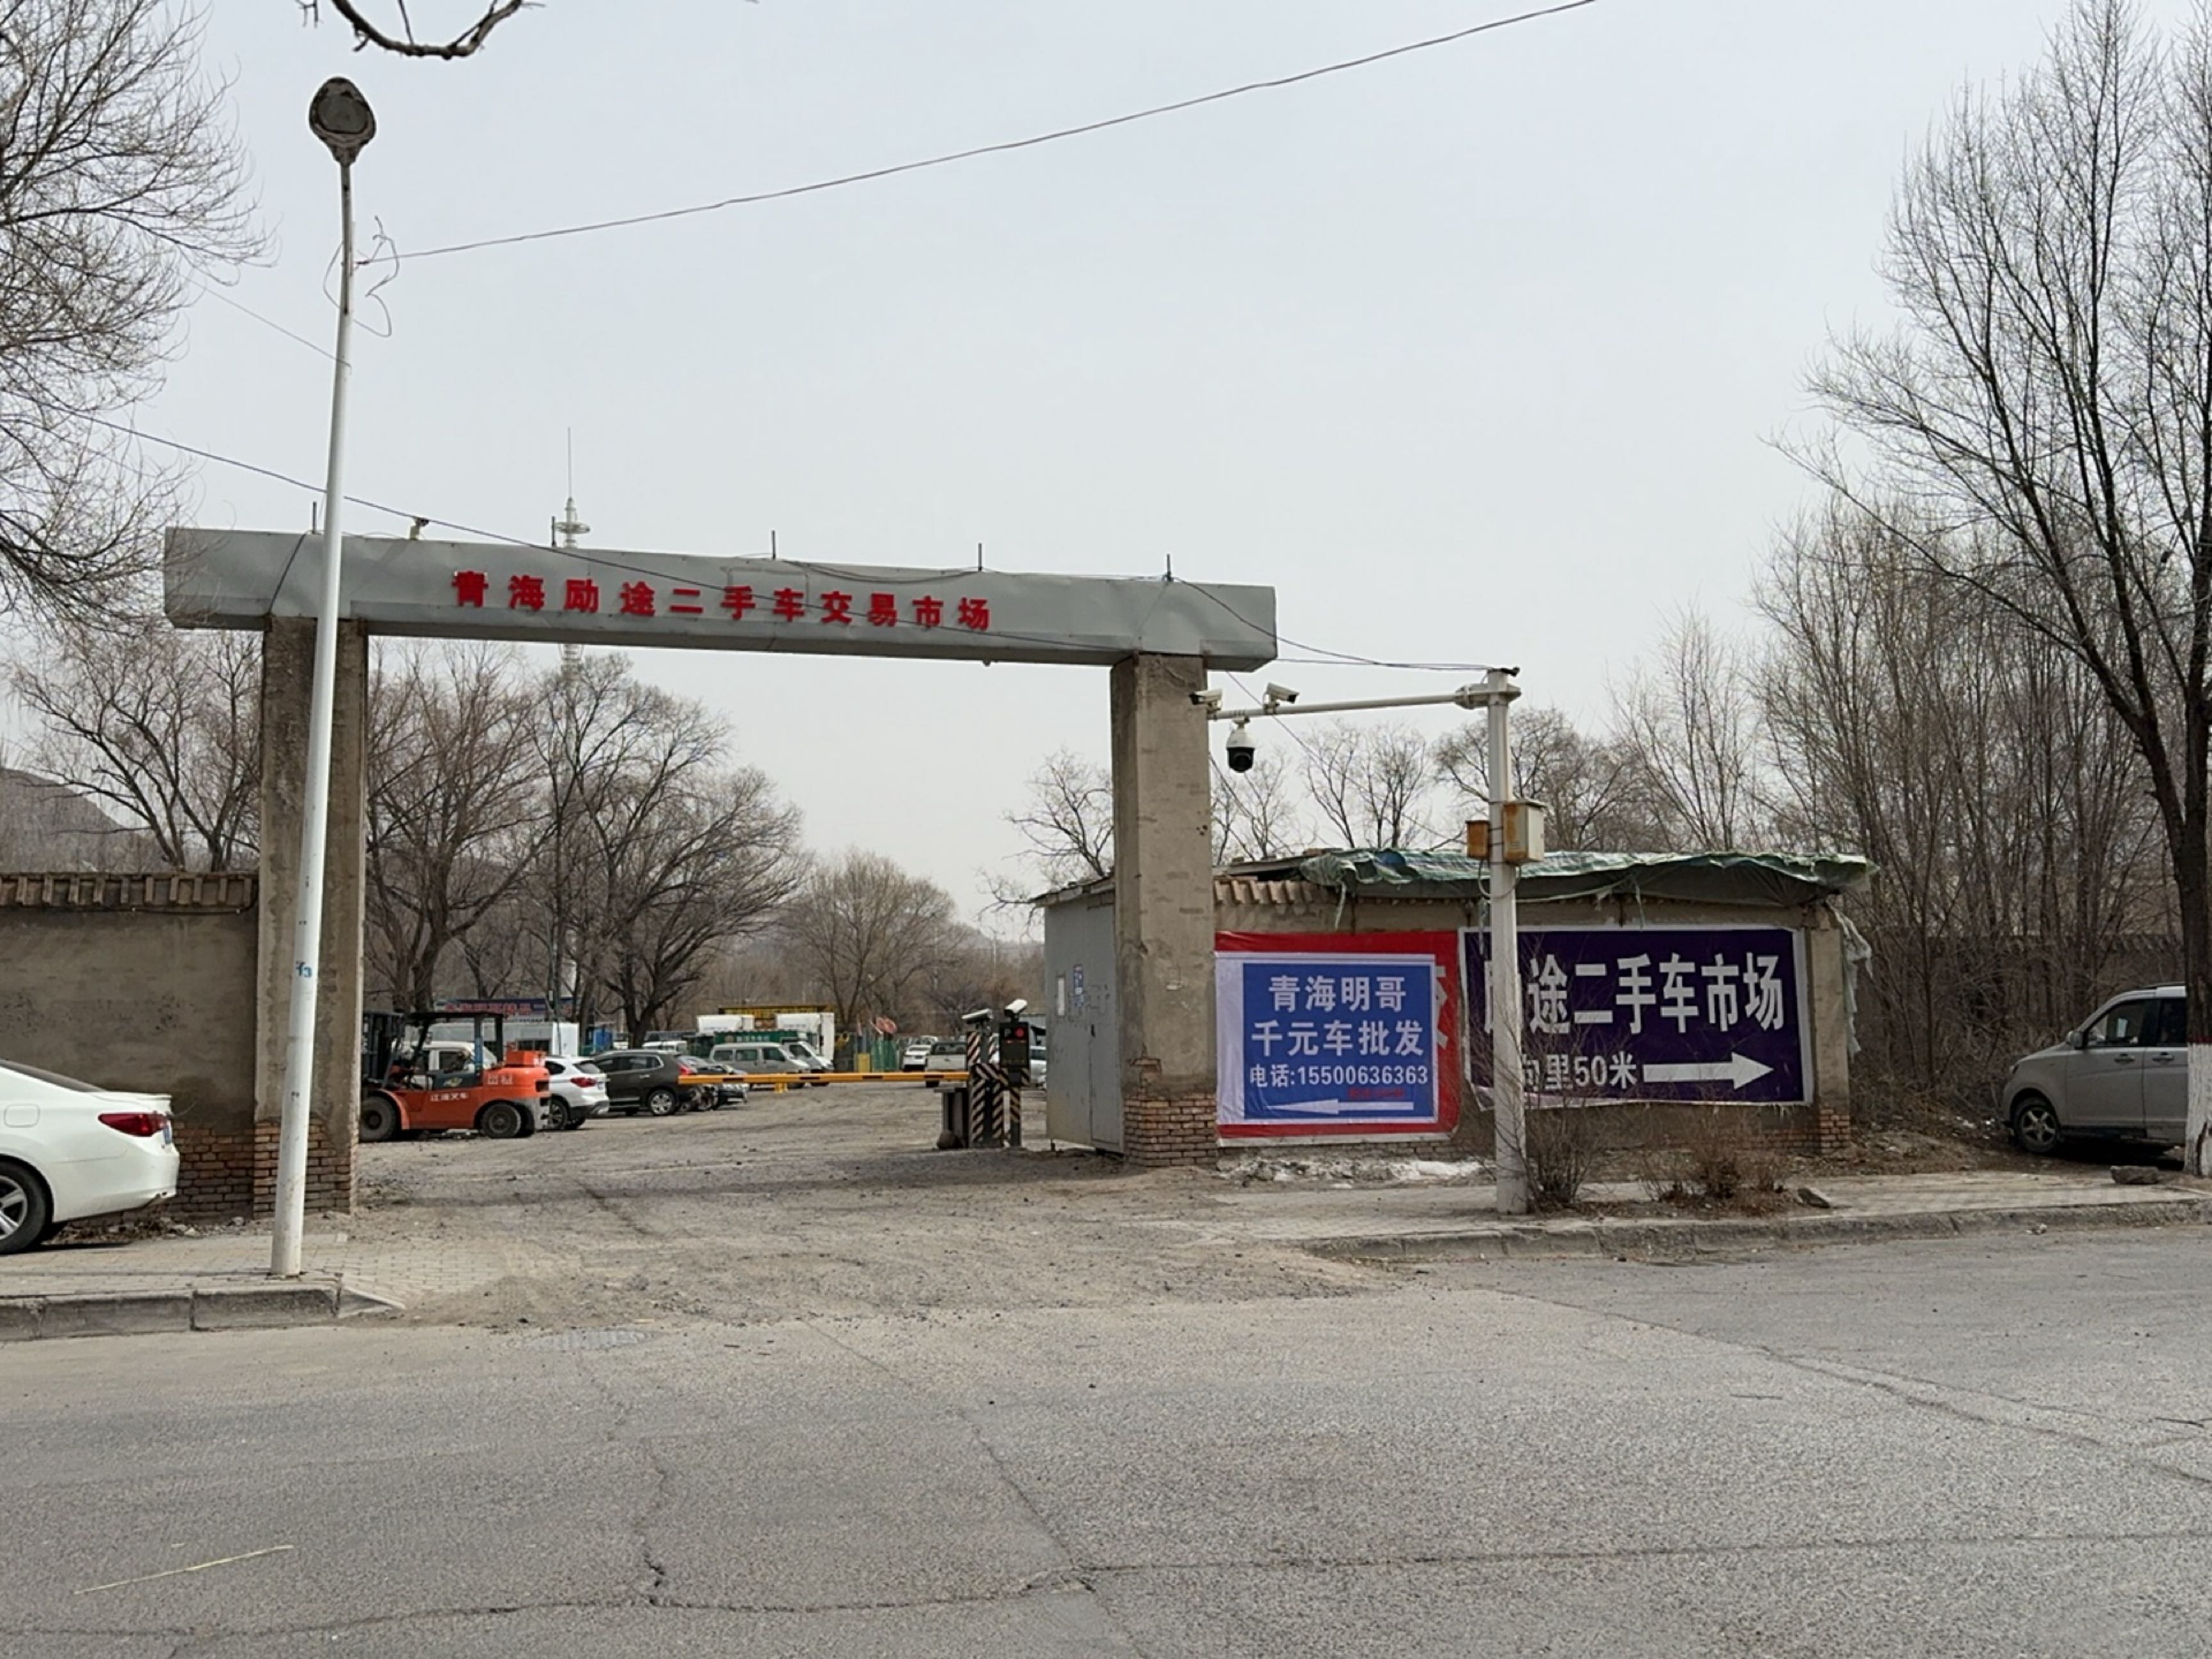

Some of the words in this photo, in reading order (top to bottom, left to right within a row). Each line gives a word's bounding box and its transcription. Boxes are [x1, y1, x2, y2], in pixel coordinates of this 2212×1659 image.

[453, 570, 990, 630] 青海励途二手车交易市场
[1268, 975, 1407, 1013] 青海明哥
[1484, 952, 1784, 1035] 途二手车市场
[1251, 1020, 1424, 1057] 千元车批发
[1249, 1063, 1429, 1088] 电话:15500636363
